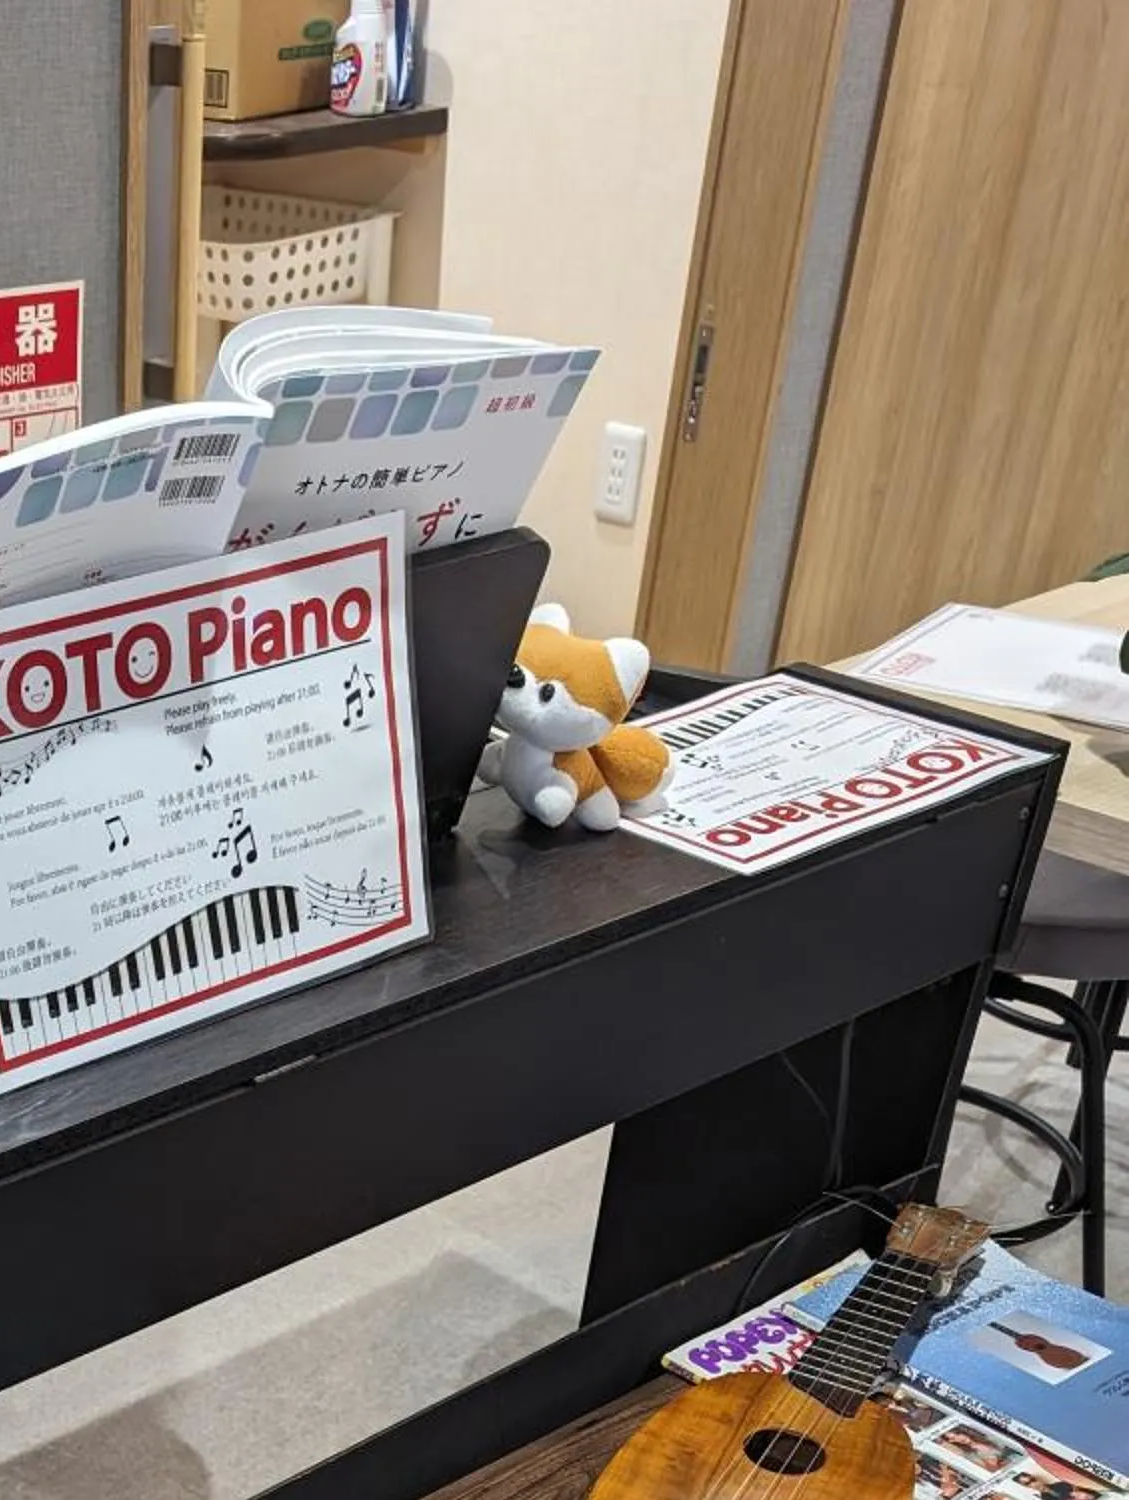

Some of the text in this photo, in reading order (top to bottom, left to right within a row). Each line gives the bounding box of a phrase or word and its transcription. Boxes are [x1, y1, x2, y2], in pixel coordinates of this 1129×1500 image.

[295, 461, 465, 495] オトナの簡単ピアノ
[188, 586, 373, 683] Piano
[164, 705, 191, 720] Please
[192, 700, 209, 714] play
[166, 722, 194, 736] Please
[222, 707, 243, 720] from
[244, 698, 275, 716] playing
[844, 738, 997, 799] KOTO
[705, 787, 866, 847] Piano
